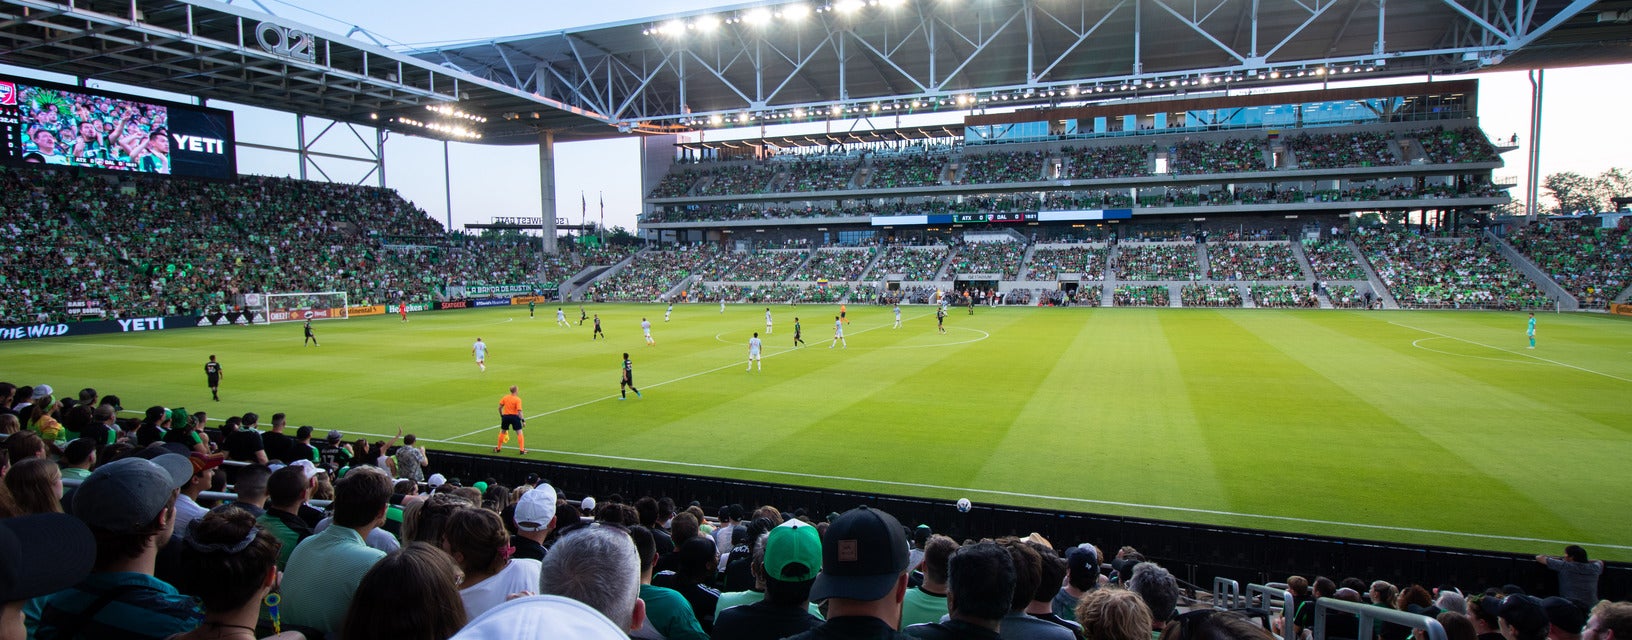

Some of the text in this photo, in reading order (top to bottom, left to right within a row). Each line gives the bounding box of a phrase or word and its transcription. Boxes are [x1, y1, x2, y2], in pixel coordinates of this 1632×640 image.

[256, 22, 310, 61] Q2
[173, 133, 224, 154] YETI
[389, 304, 423, 313] Heeken
[0, 323, 69, 340] THE WILD
[118, 317, 164, 332] YETI
